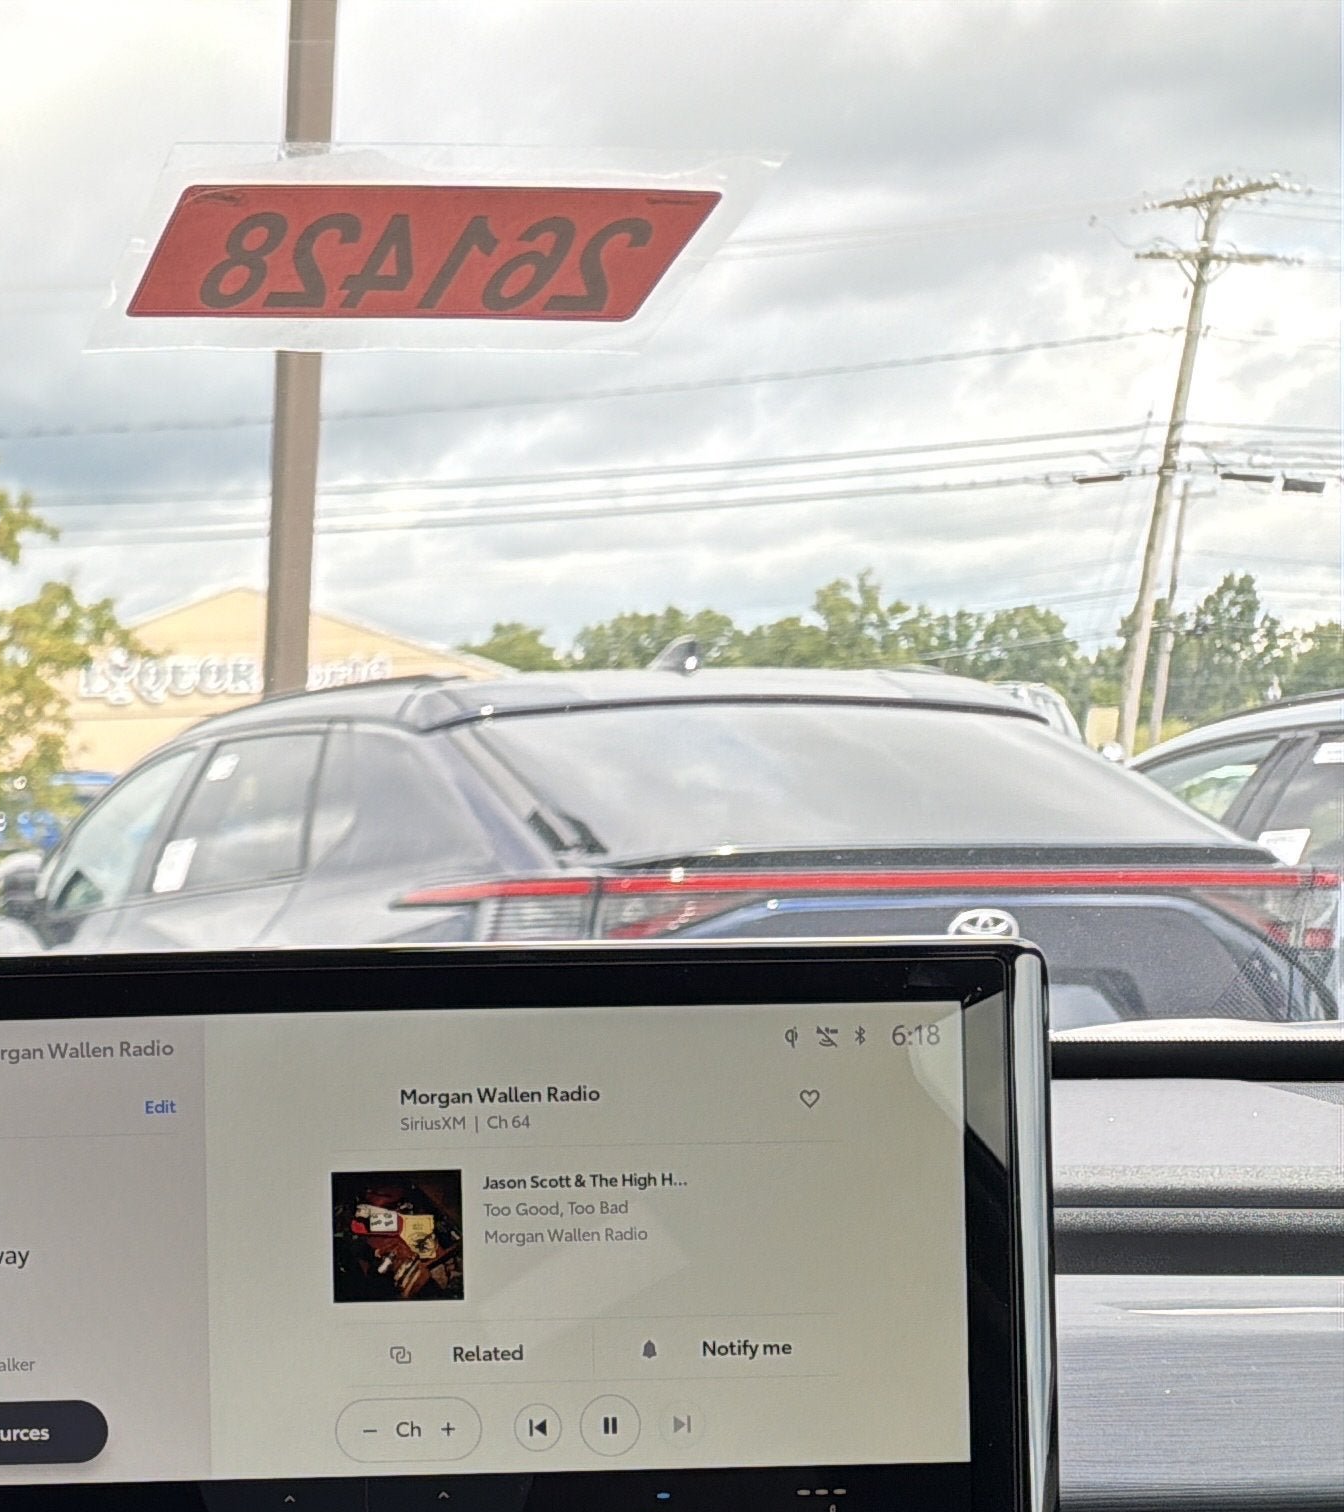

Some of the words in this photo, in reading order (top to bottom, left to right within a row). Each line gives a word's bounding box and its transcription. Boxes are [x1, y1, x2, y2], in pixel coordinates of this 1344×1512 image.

[890, 1025, 941, 1047] 6:18
[48, 1042, 114, 1060] Wallen
[119, 1040, 174, 1057] Radio
[144, 1100, 177, 1114] Edit
[400, 1087, 473, 1110] Morgan
[477, 1085, 542, 1106] Wallen
[547, 1084, 600, 1104] Radio
[400, 1115, 467, 1132] SiriusXM
[487, 1114, 509, 1130] Ch
[512, 1114, 531, 1130] 64
[483, 1175, 526, 1191] Jason
[529, 1174, 571, 1190] Scott
[574, 1174, 587, 1189] &
[590, 1173, 616, 1189] The
[621, 1172, 656, 1192] High
[484, 1202, 511, 1217] Too
[515, 1201, 564, 1219] Good,
[568, 1201, 596, 1216] Too
[600, 1200, 629, 1215] Bad
[484, 1230, 544, 1247] Morgan
[547, 1228, 600, 1244] Wallen
[604, 1227, 648, 1242] Radio
[452, 1343, 524, 1362] Related
[702, 1339, 758, 1360] Notify
[760, 1343, 793, 1357] me
[396, 1421, 422, 1439] Ch
